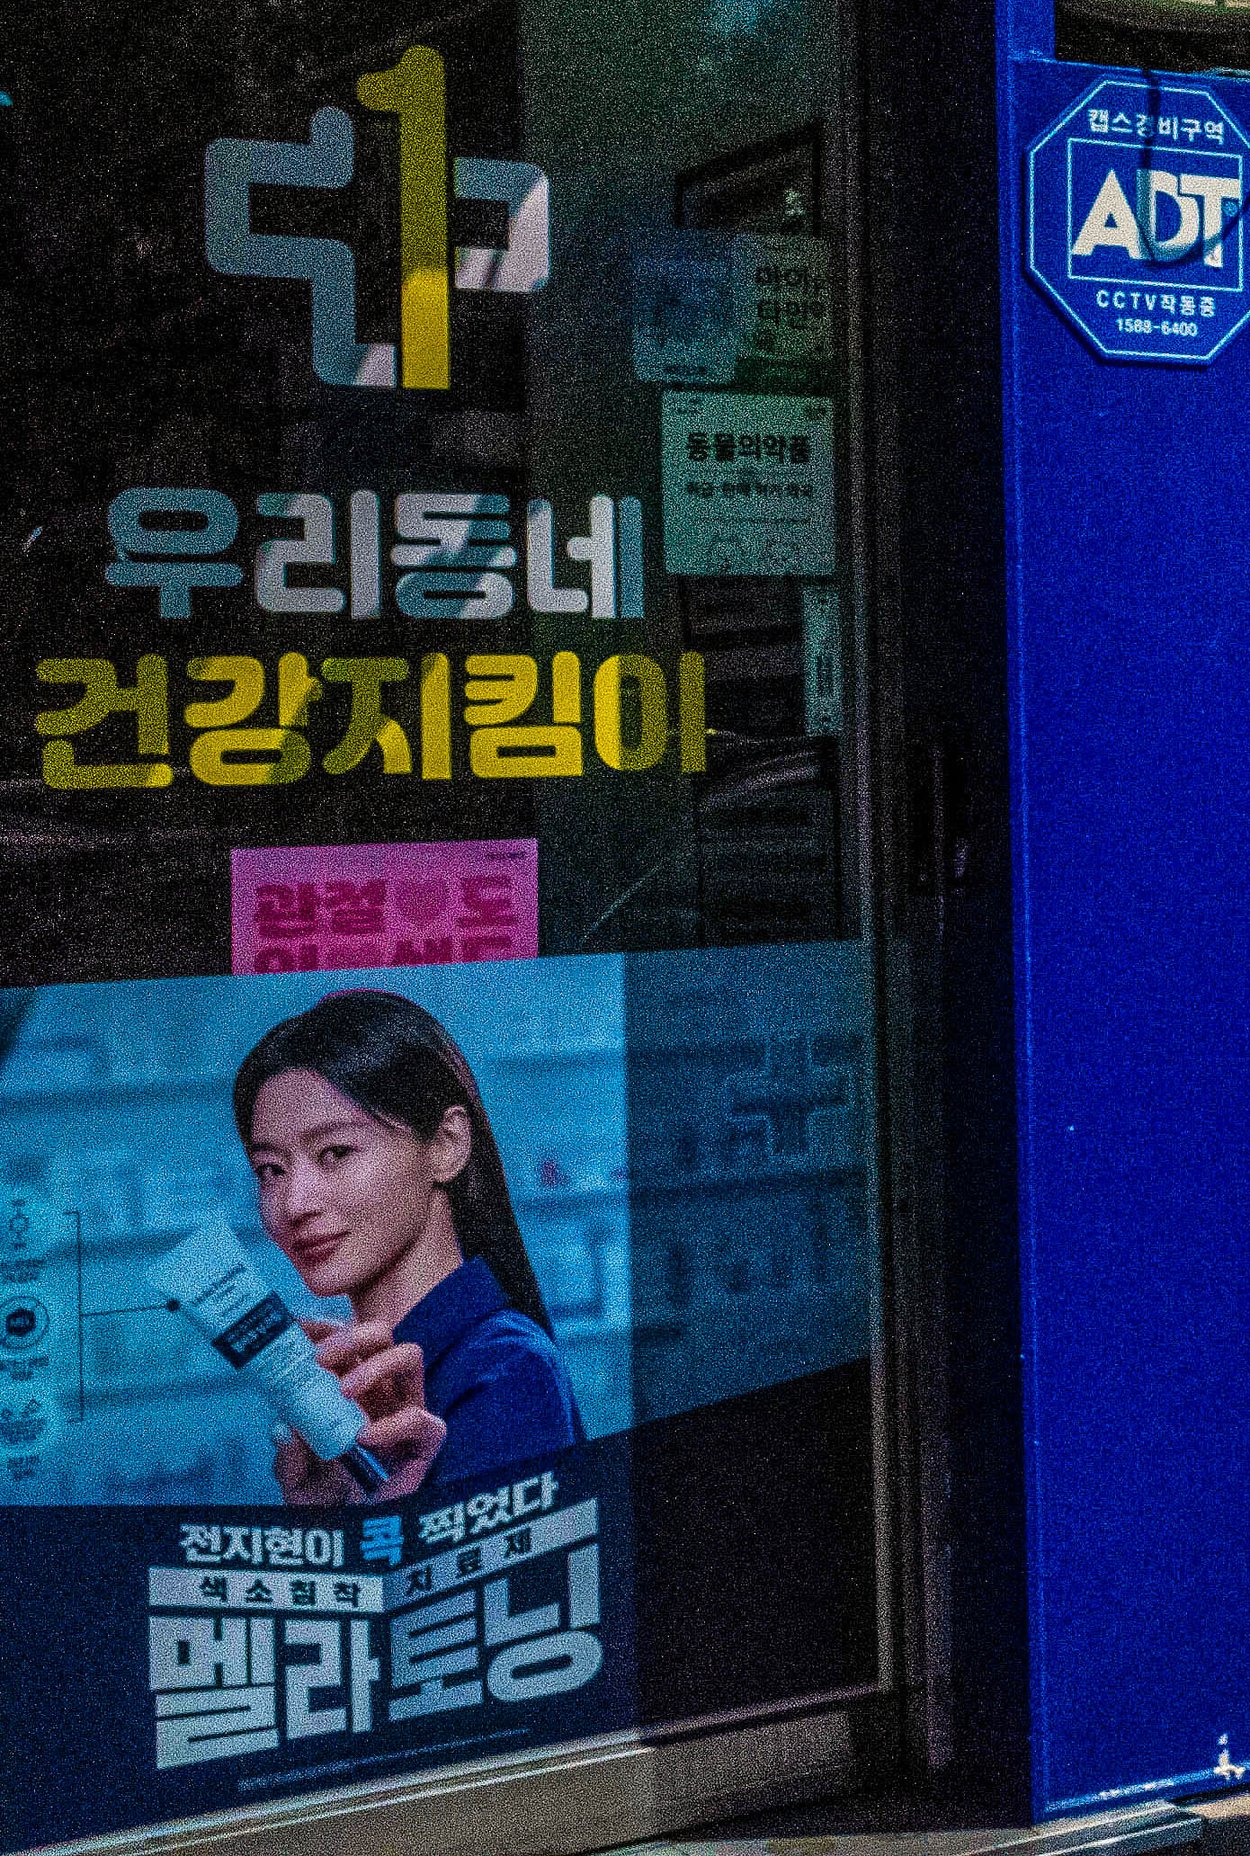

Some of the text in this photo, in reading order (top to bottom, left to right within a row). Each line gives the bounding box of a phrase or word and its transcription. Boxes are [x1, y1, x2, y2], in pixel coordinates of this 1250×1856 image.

[1071, 168, 1240, 268] ADT
[1116, 318, 1198, 337] 1588-6400
[686, 431, 811, 464] 동물의약품
[104, 487, 645, 620] 우리동네
[34, 650, 706, 790] 건강지킴이
[255, 875, 517, 938] 관절 도
[179, 1471, 559, 1568] 전지현이 콕 찍었다
[199, 1576, 361, 1608] 색소침착
[148, 1543, 604, 1771] 멜라토닝
